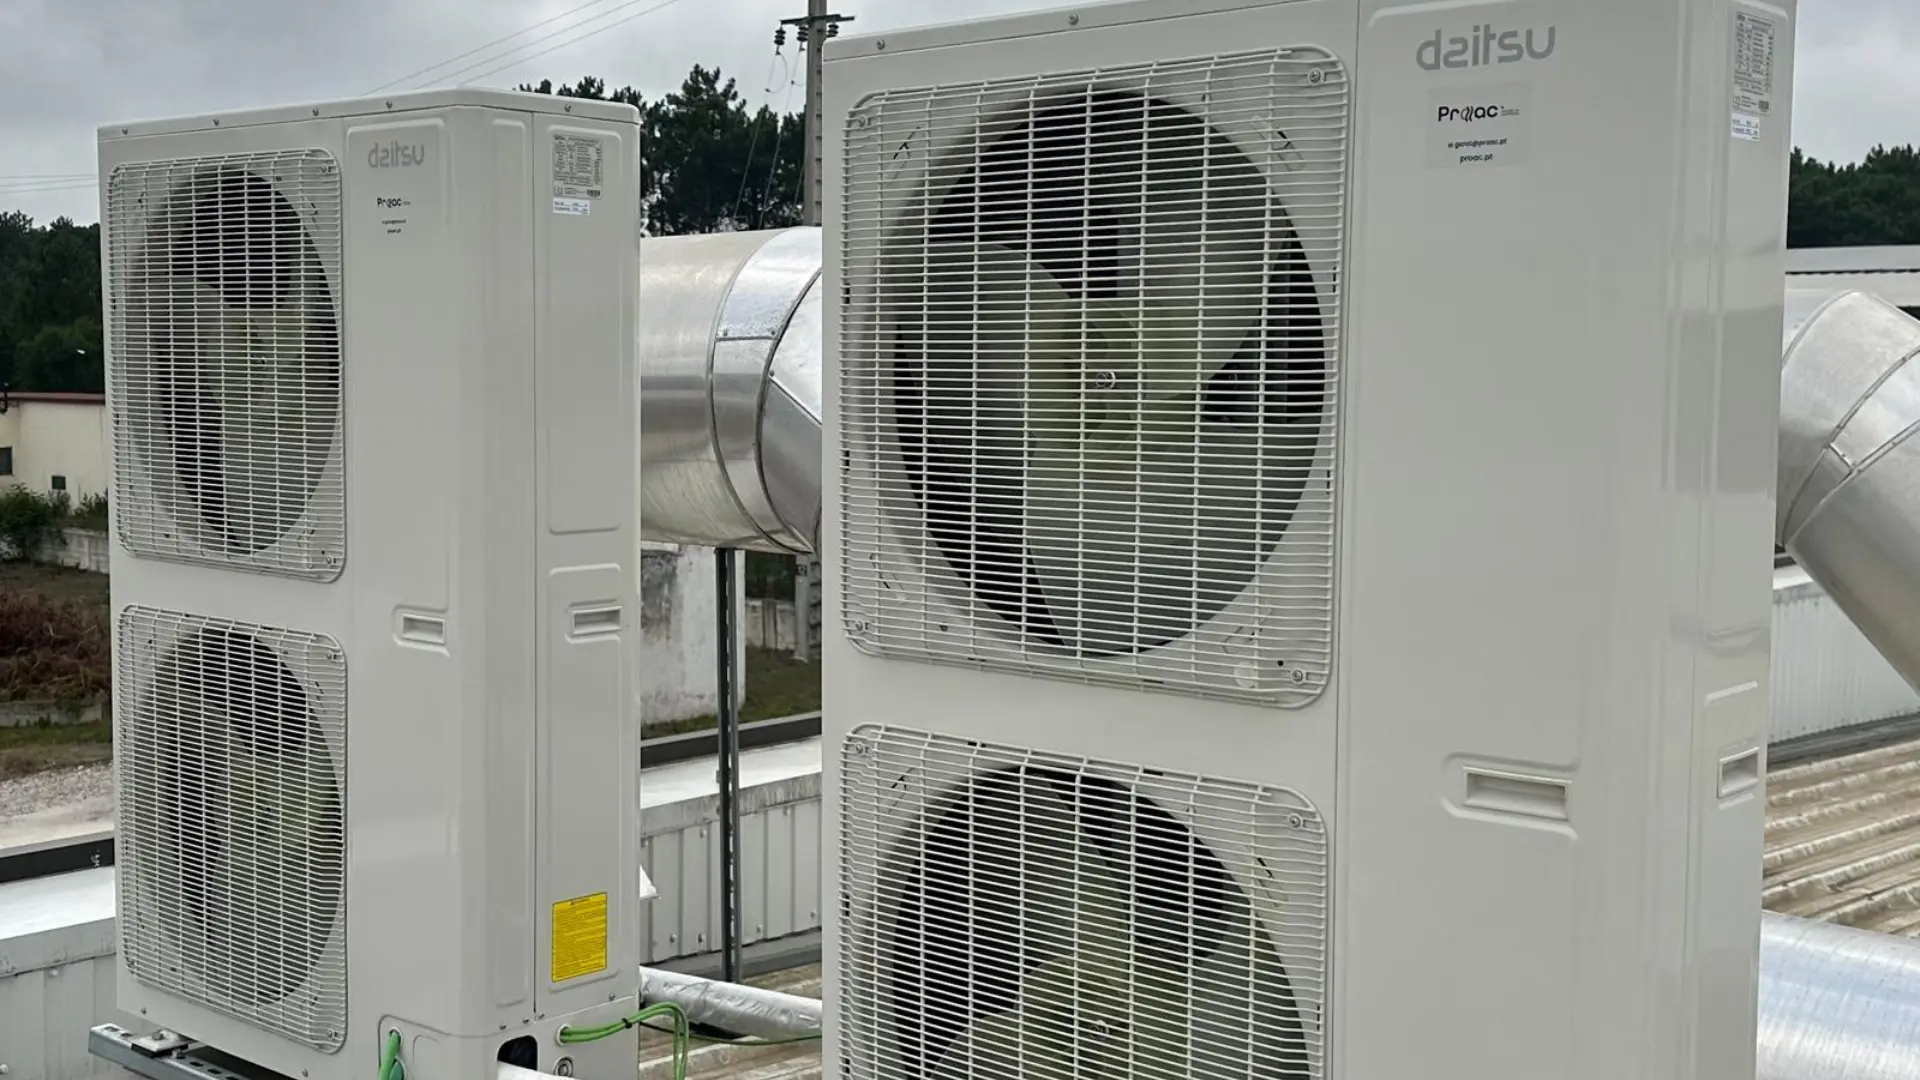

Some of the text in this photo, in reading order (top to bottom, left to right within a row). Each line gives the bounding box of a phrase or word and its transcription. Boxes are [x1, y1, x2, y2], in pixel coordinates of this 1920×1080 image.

[1416, 24, 1555, 71] daitsu
[368, 140, 424, 168] daitsu
[1460, 154, 1493, 164] proac.pt
